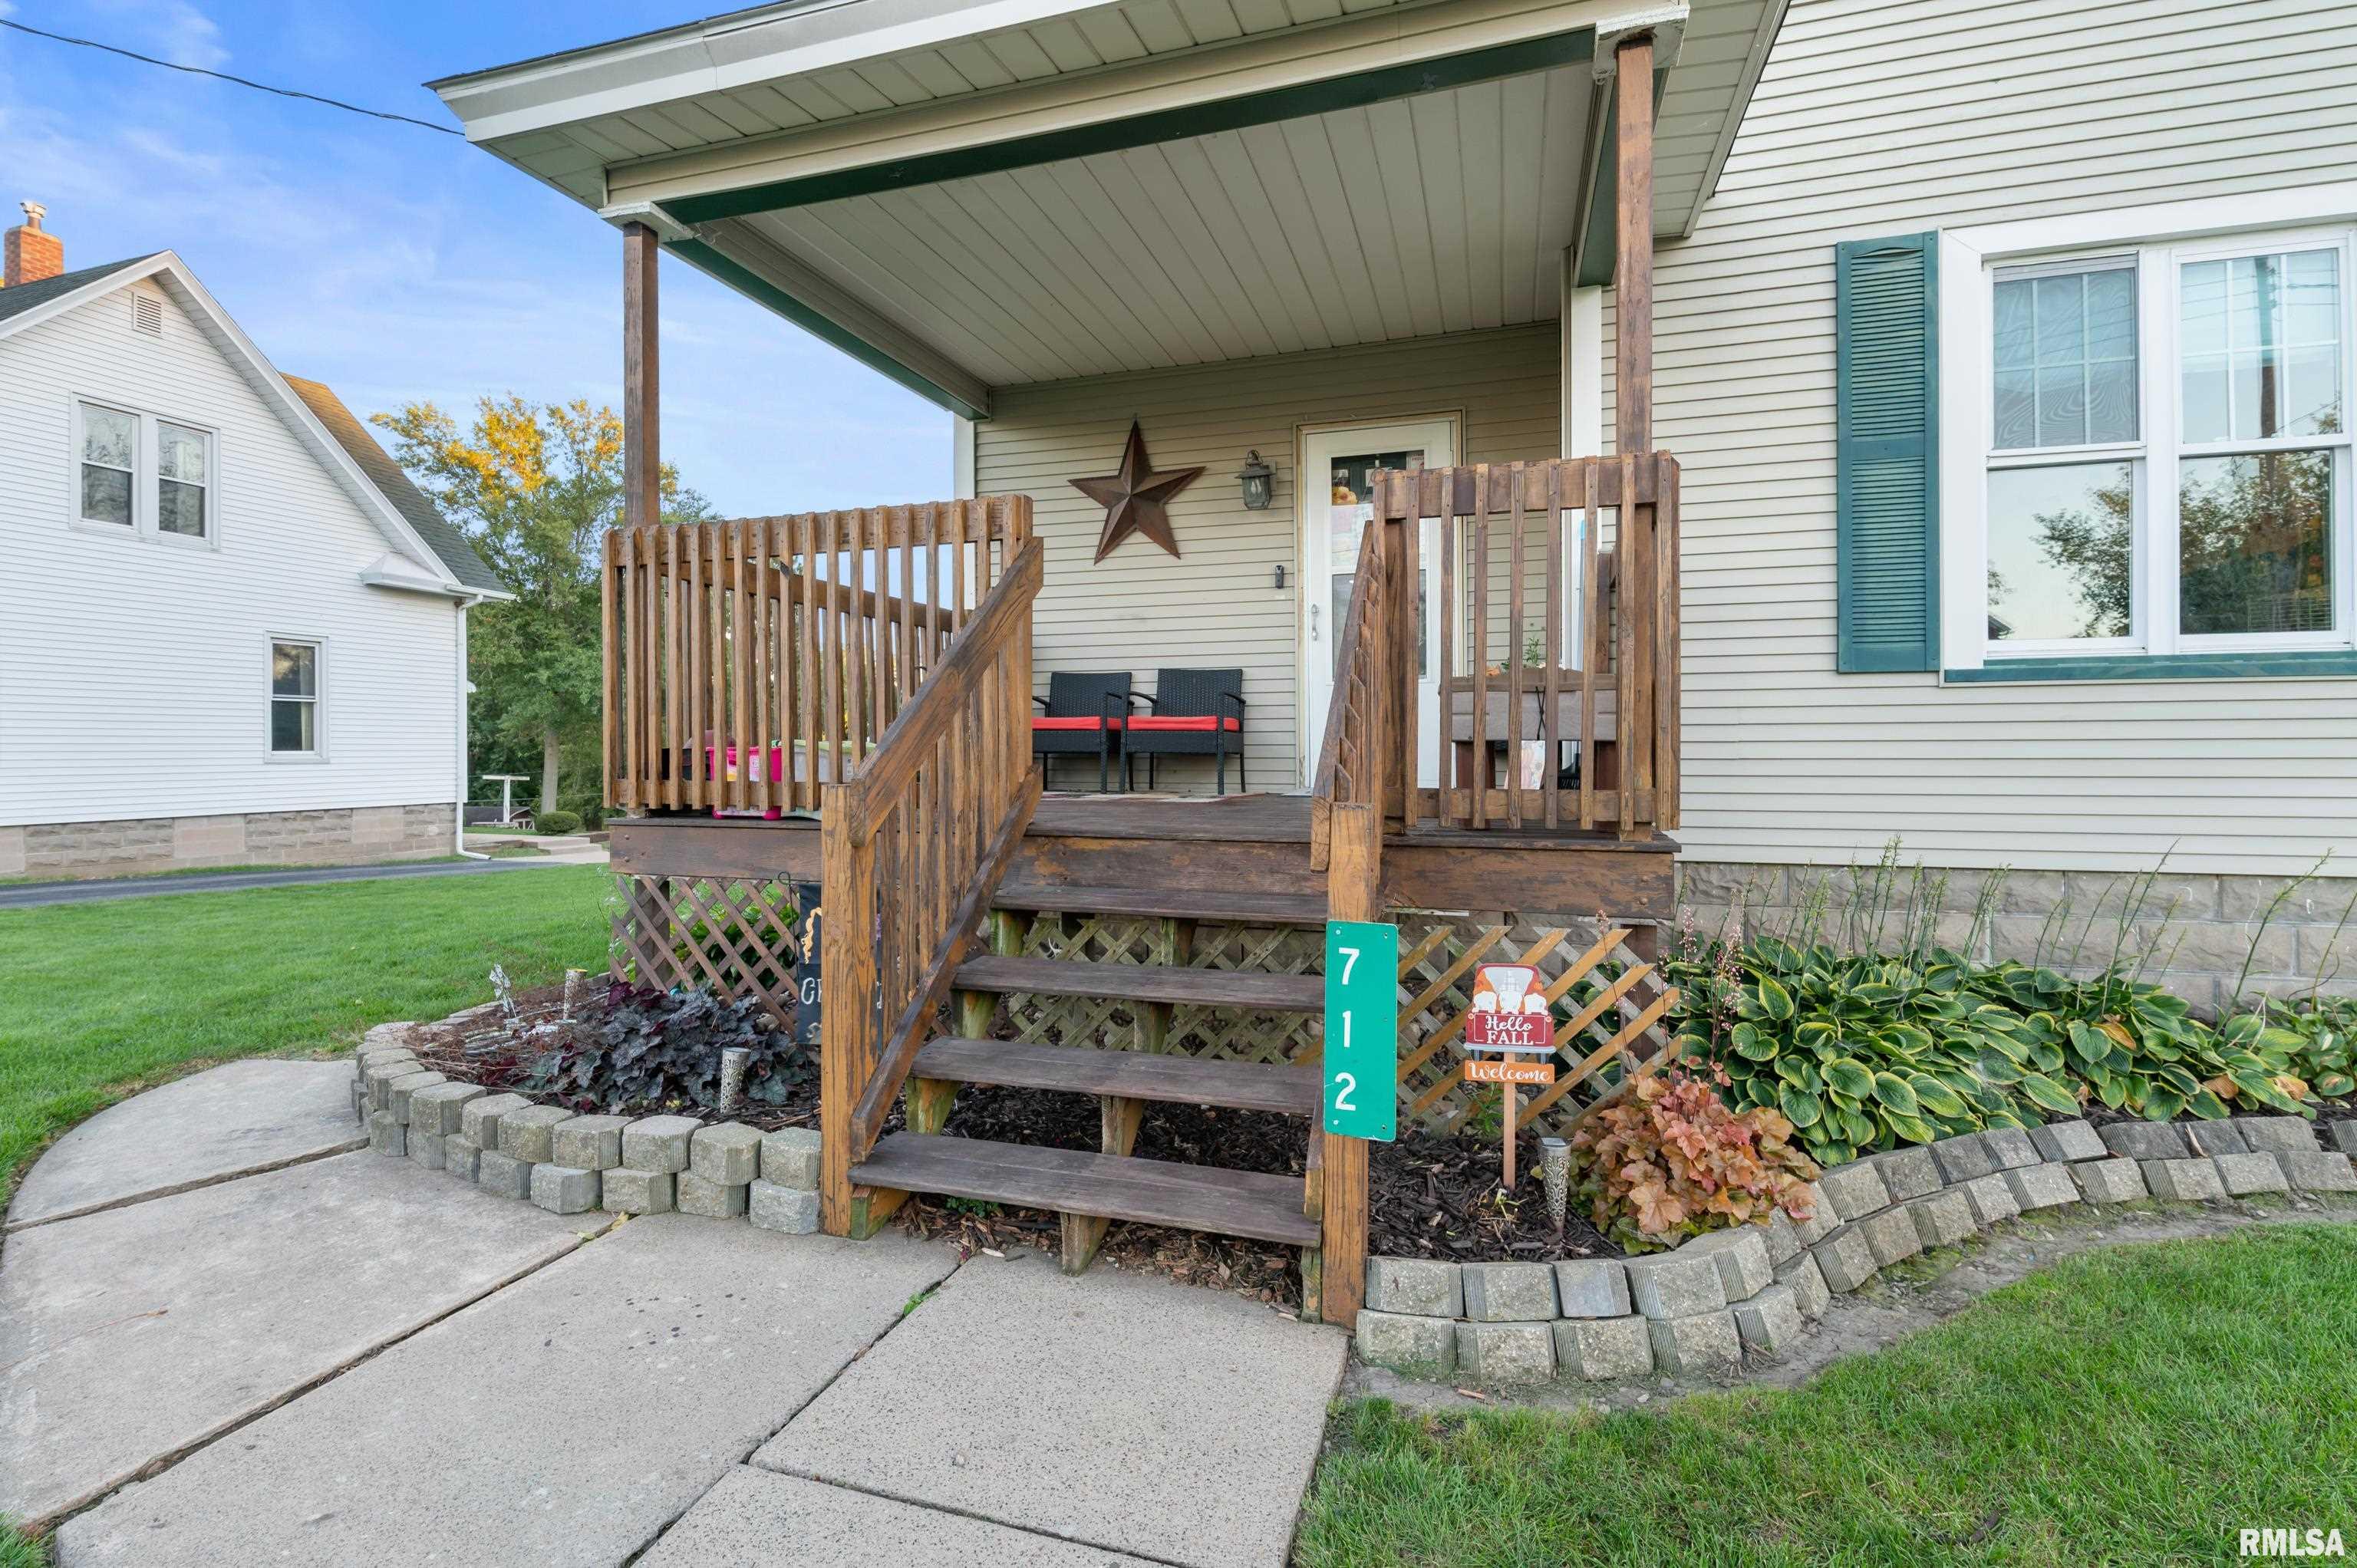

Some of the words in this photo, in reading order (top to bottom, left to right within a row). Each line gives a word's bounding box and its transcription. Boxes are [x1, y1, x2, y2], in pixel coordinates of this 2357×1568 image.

[1485, 1015, 1534, 1031] Hello
[1486, 1030, 1534, 1046] FALL
[1469, 1062, 1551, 1082] Welcome
